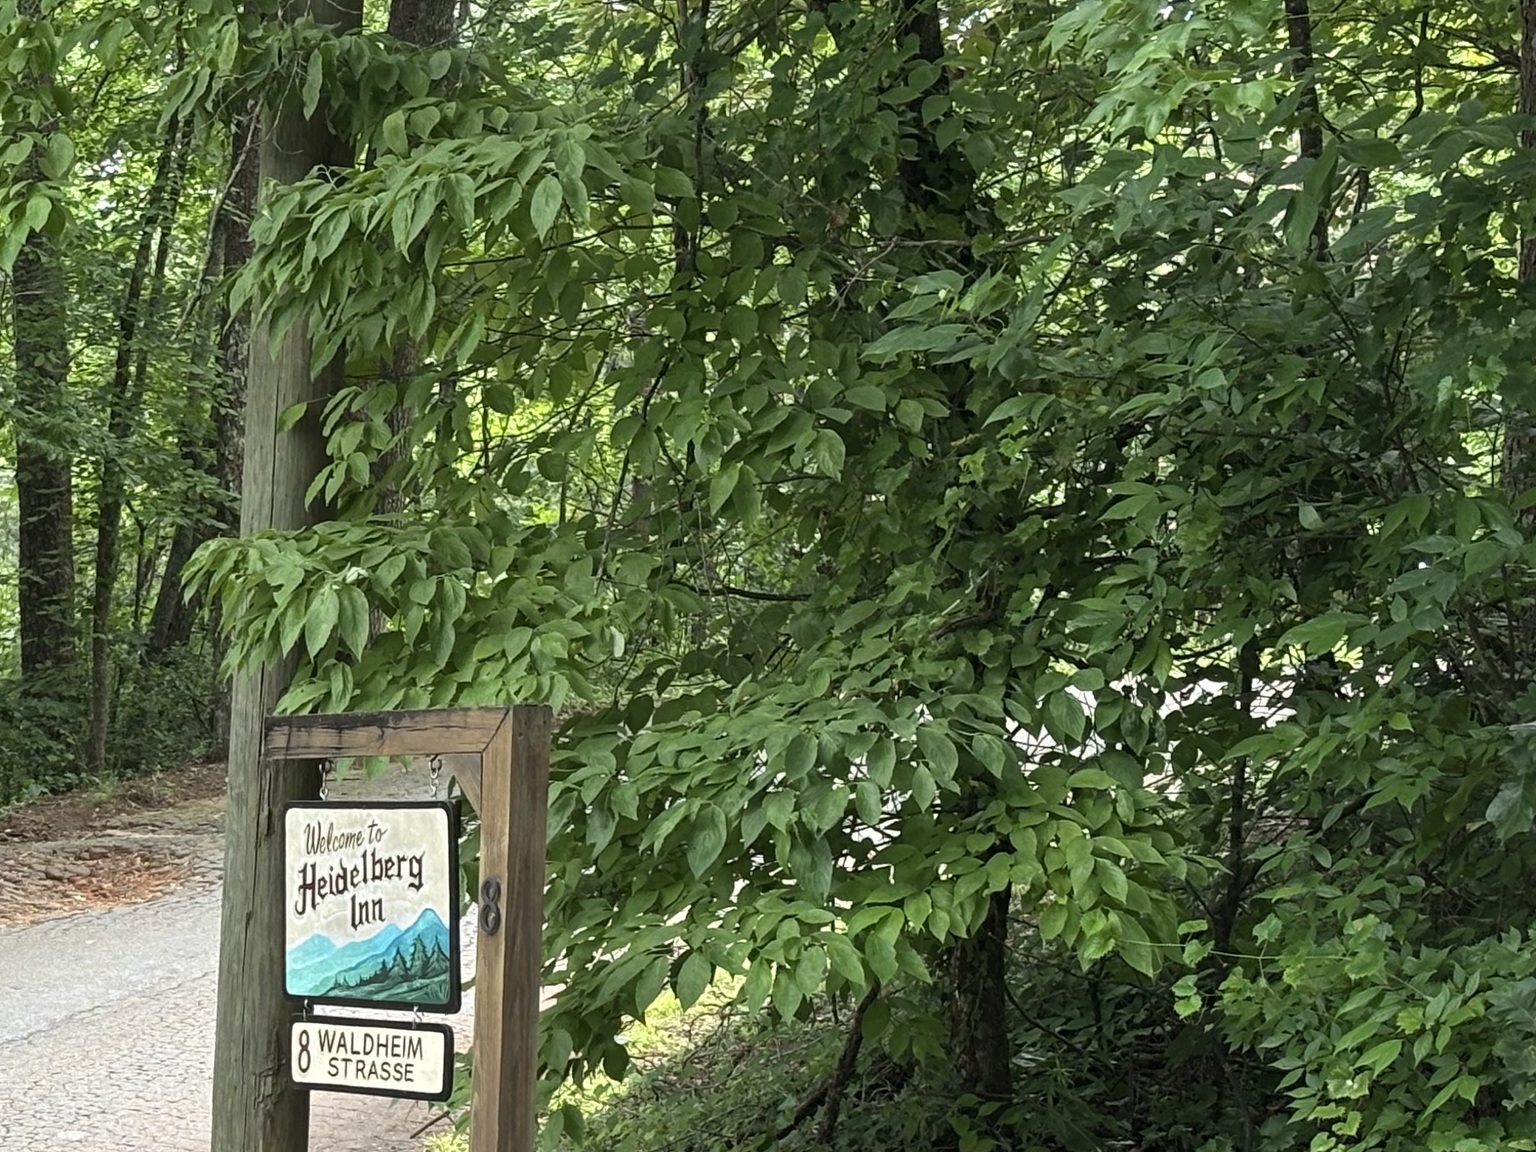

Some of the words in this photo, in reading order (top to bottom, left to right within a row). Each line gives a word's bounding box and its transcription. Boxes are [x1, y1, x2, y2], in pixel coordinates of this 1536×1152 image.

[304, 820, 364, 854] Welcome
[368, 819, 388, 844] to
[295, 848, 426, 915] Heidelberg
[350, 894, 385, 930] Inn
[481, 876, 500, 935] 8
[298, 1029, 311, 1073] 8
[318, 1029, 423, 1060] WALDHEIM
[327, 1057, 414, 1082] STRASSE
